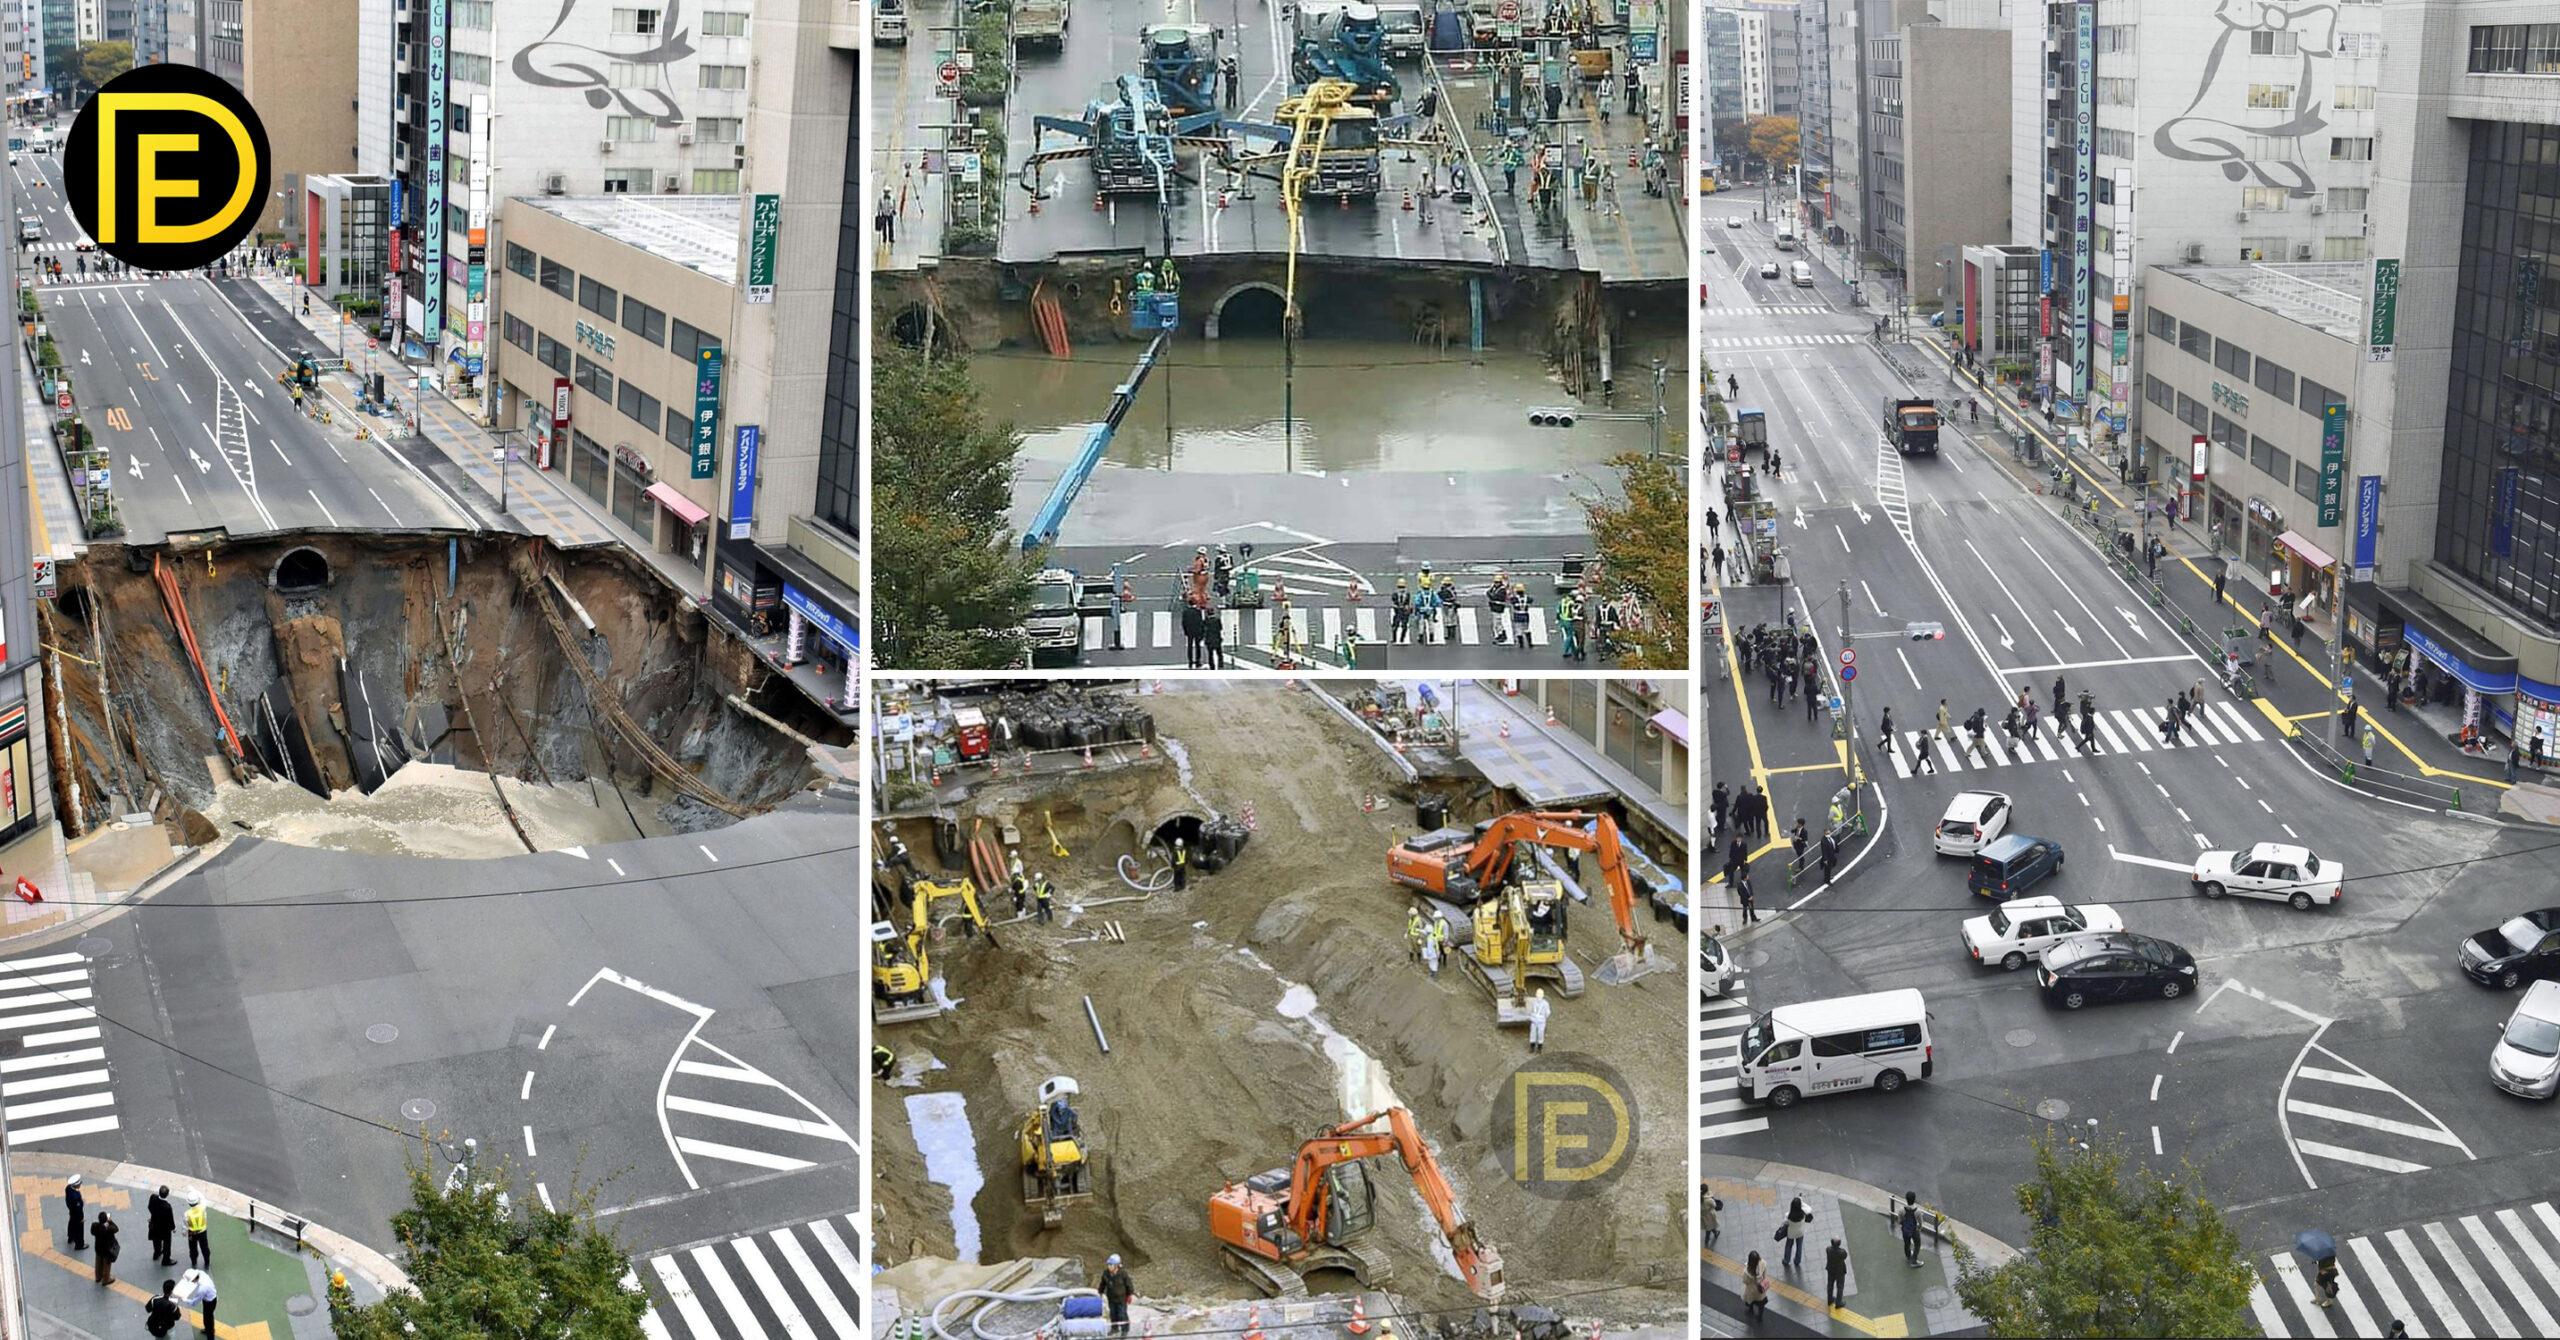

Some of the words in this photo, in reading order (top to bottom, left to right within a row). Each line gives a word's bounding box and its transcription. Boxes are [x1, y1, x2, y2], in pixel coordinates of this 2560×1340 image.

[768, 199, 778, 236] マサキ
[2388, 263, 2399, 297] マサキ
[107, 407, 133, 432] 40
[697, 410, 714, 472] 伊予銀行
[738, 429, 750, 491] アパマンショップ
[2323, 462, 2339, 521] 伊予銀行
[1843, 653, 1853, 661] 40
